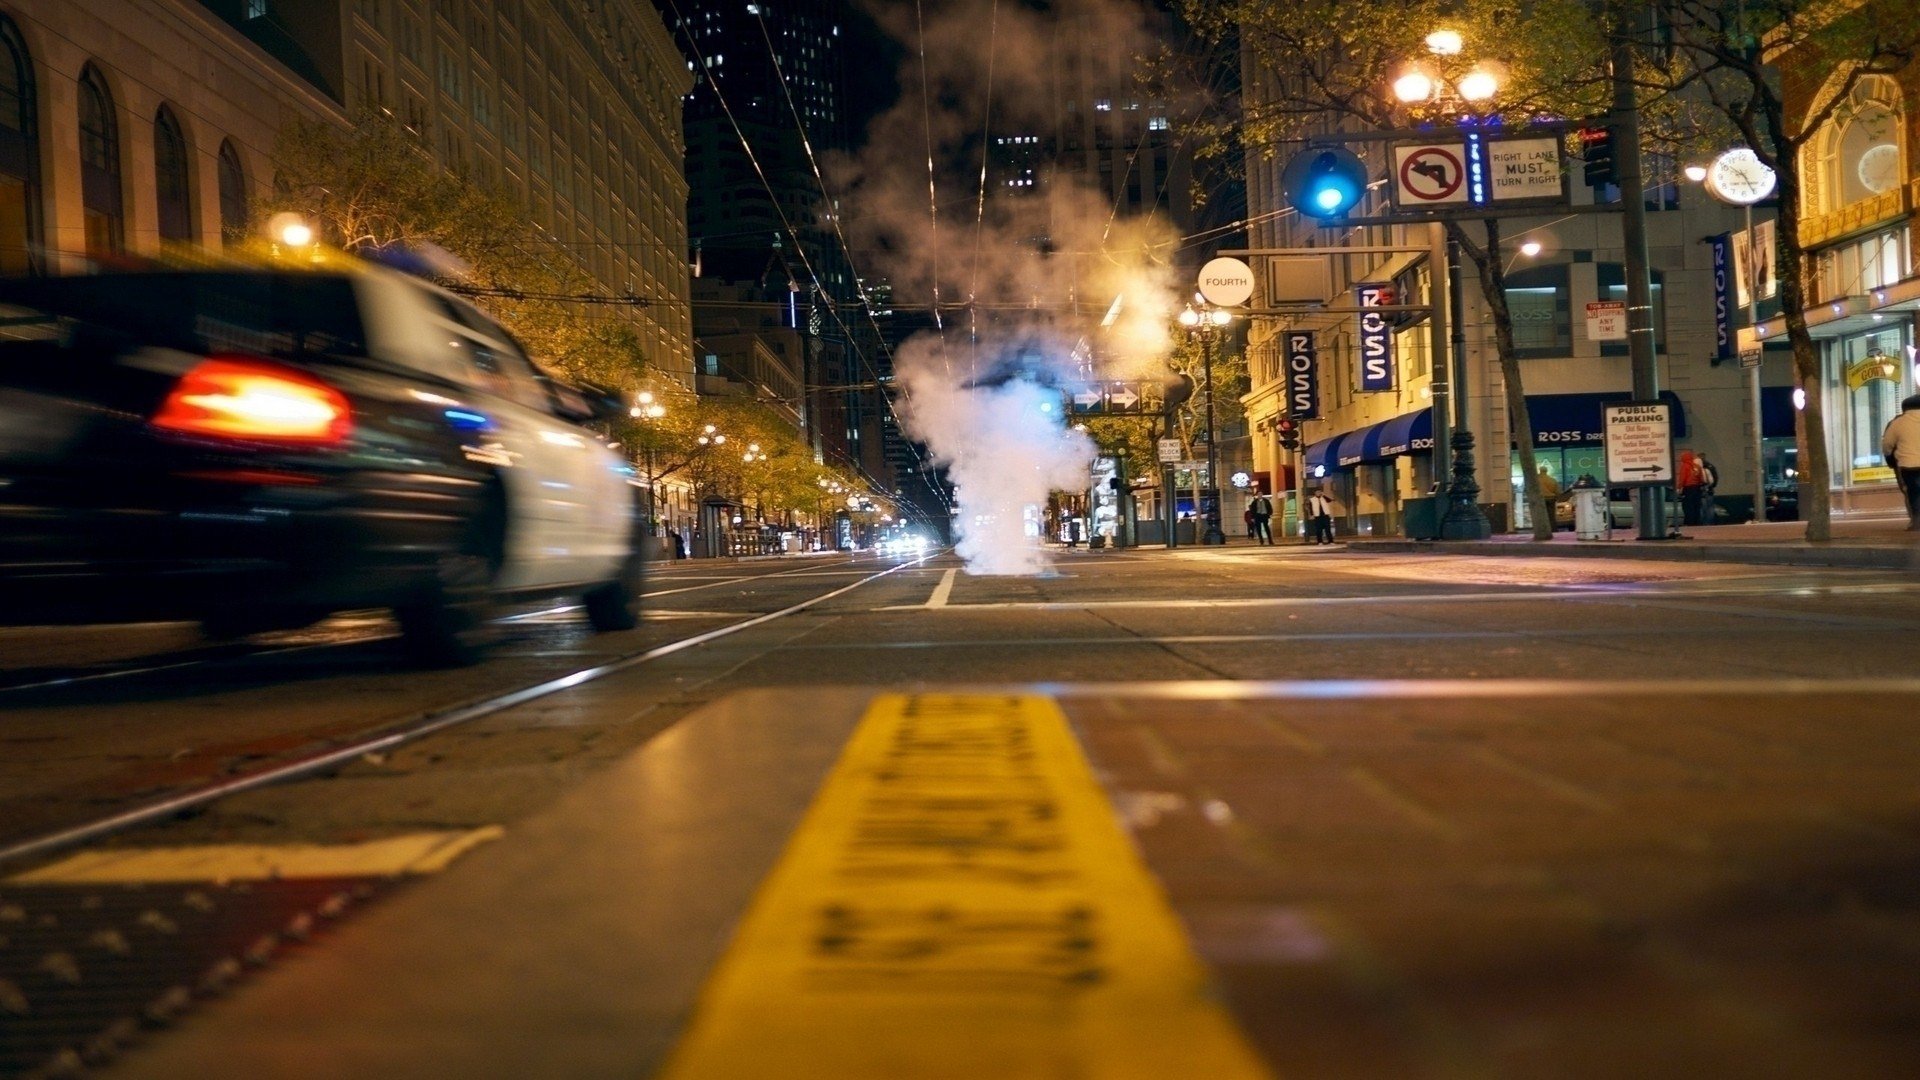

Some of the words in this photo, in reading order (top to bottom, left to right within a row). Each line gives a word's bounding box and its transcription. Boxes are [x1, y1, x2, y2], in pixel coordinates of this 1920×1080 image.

[1493, 152, 1522, 162] RIGHT
[1528, 151, 1554, 160] LANE
[1506, 163, 1543, 175] MUST
[1496, 178, 1522, 187] TURN
[1528, 175, 1557, 185] RIGHT
[1206, 278, 1247, 286] FOURTH
[1715, 243, 1727, 346] ROSS
[1587, 310, 1598, 319] NO
[1362, 289, 1386, 380] ROSS
[1291, 336, 1311, 410] ROSS
[1618, 406, 1657, 415] PUBLIC
[1611, 414, 1664, 423] PARKING
[1538, 431, 1581, 442] ROSS
